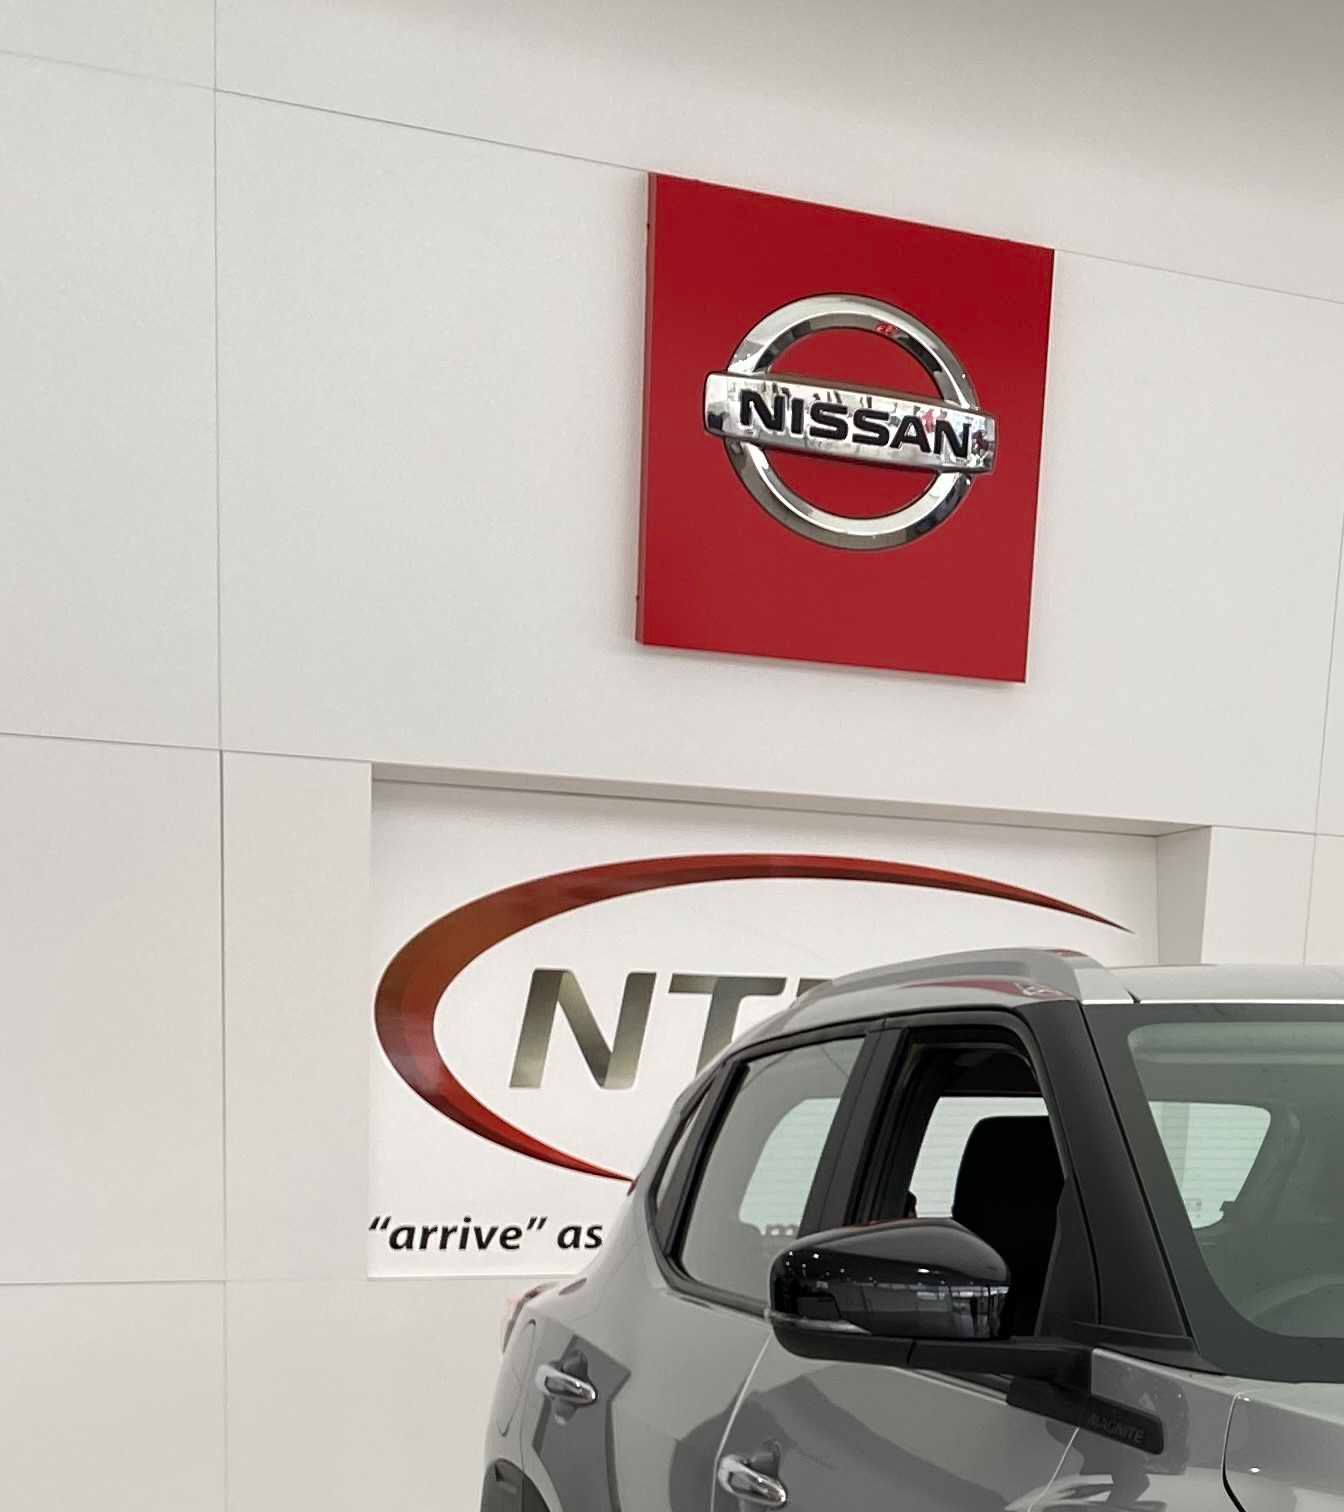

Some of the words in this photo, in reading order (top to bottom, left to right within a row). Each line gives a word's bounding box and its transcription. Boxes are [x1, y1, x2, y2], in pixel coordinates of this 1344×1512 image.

[738, 389, 971, 458] NISSAN
[509, 967, 834, 1090] NT
[557, 1225, 604, 1250] as
